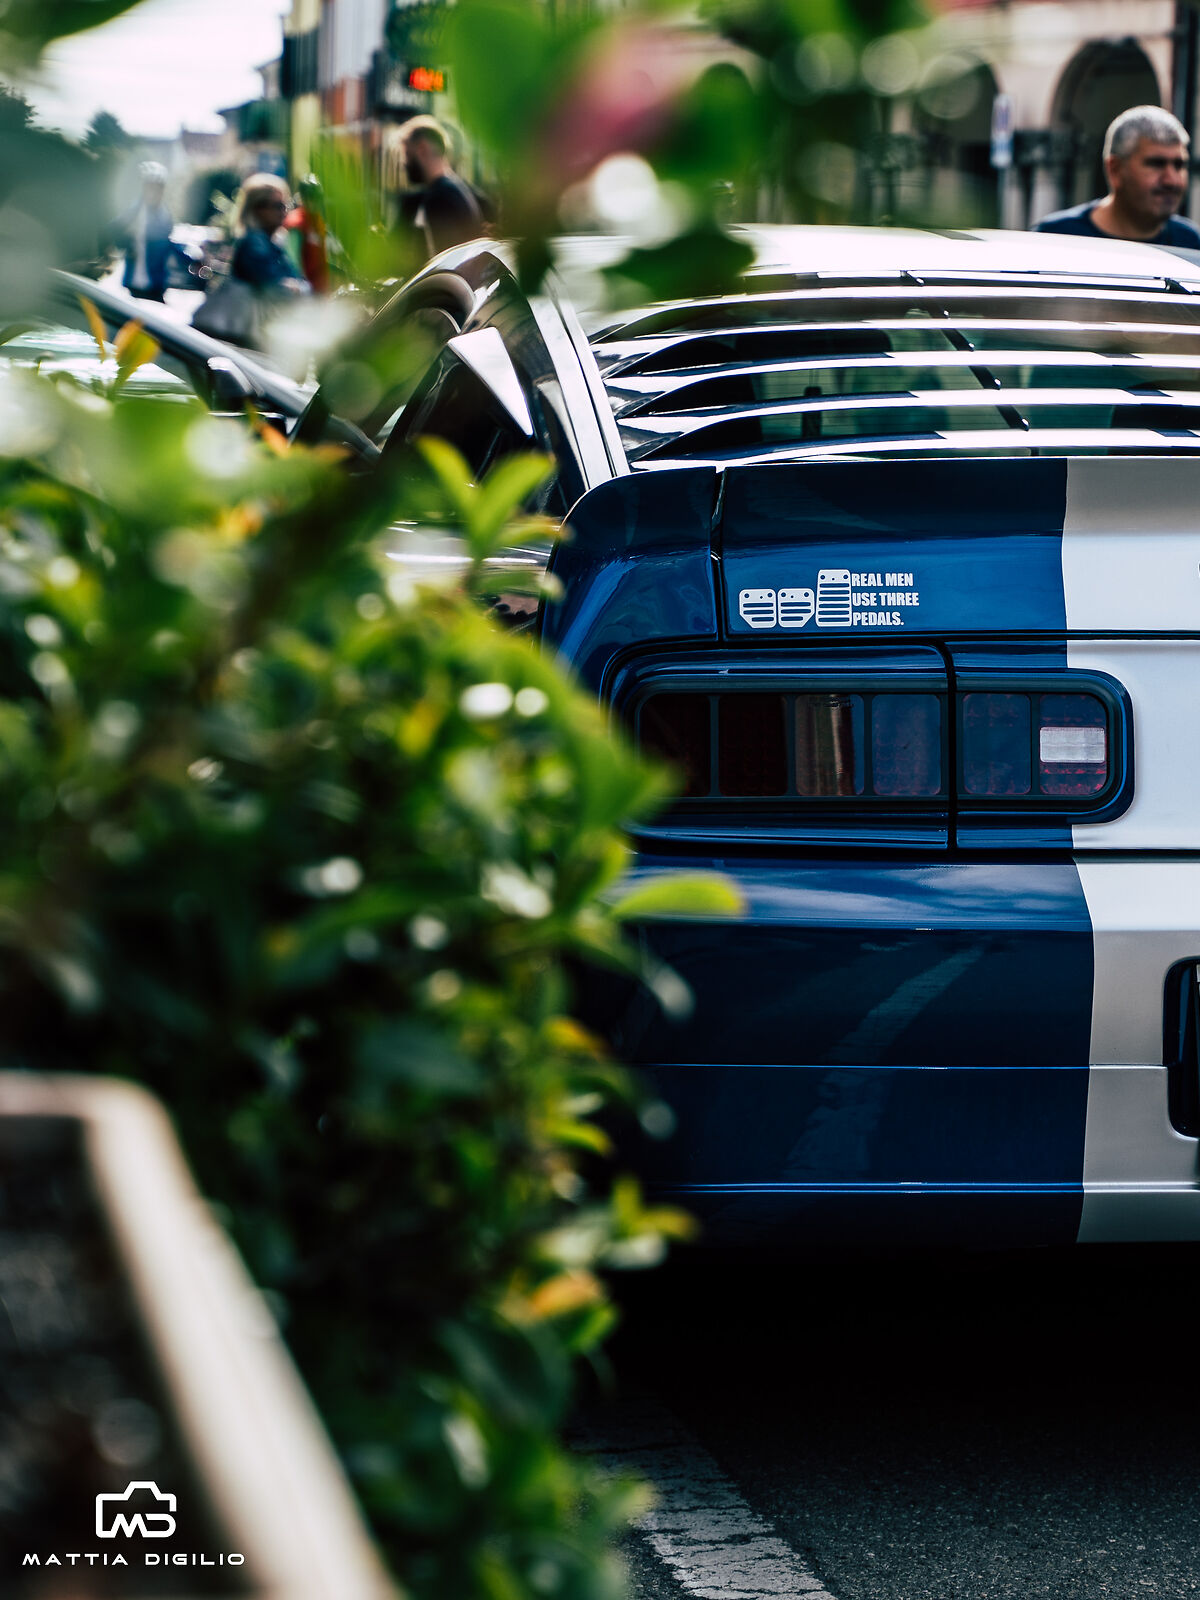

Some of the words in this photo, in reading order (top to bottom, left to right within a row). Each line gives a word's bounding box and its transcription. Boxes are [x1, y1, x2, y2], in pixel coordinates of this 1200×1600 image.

[851, 573, 883, 587] REAL
[885, 573, 913, 587] MEN
[852, 592, 877, 606] USE
[879, 592, 920, 607] THREE
[852, 612, 905, 626] PEDALS.
